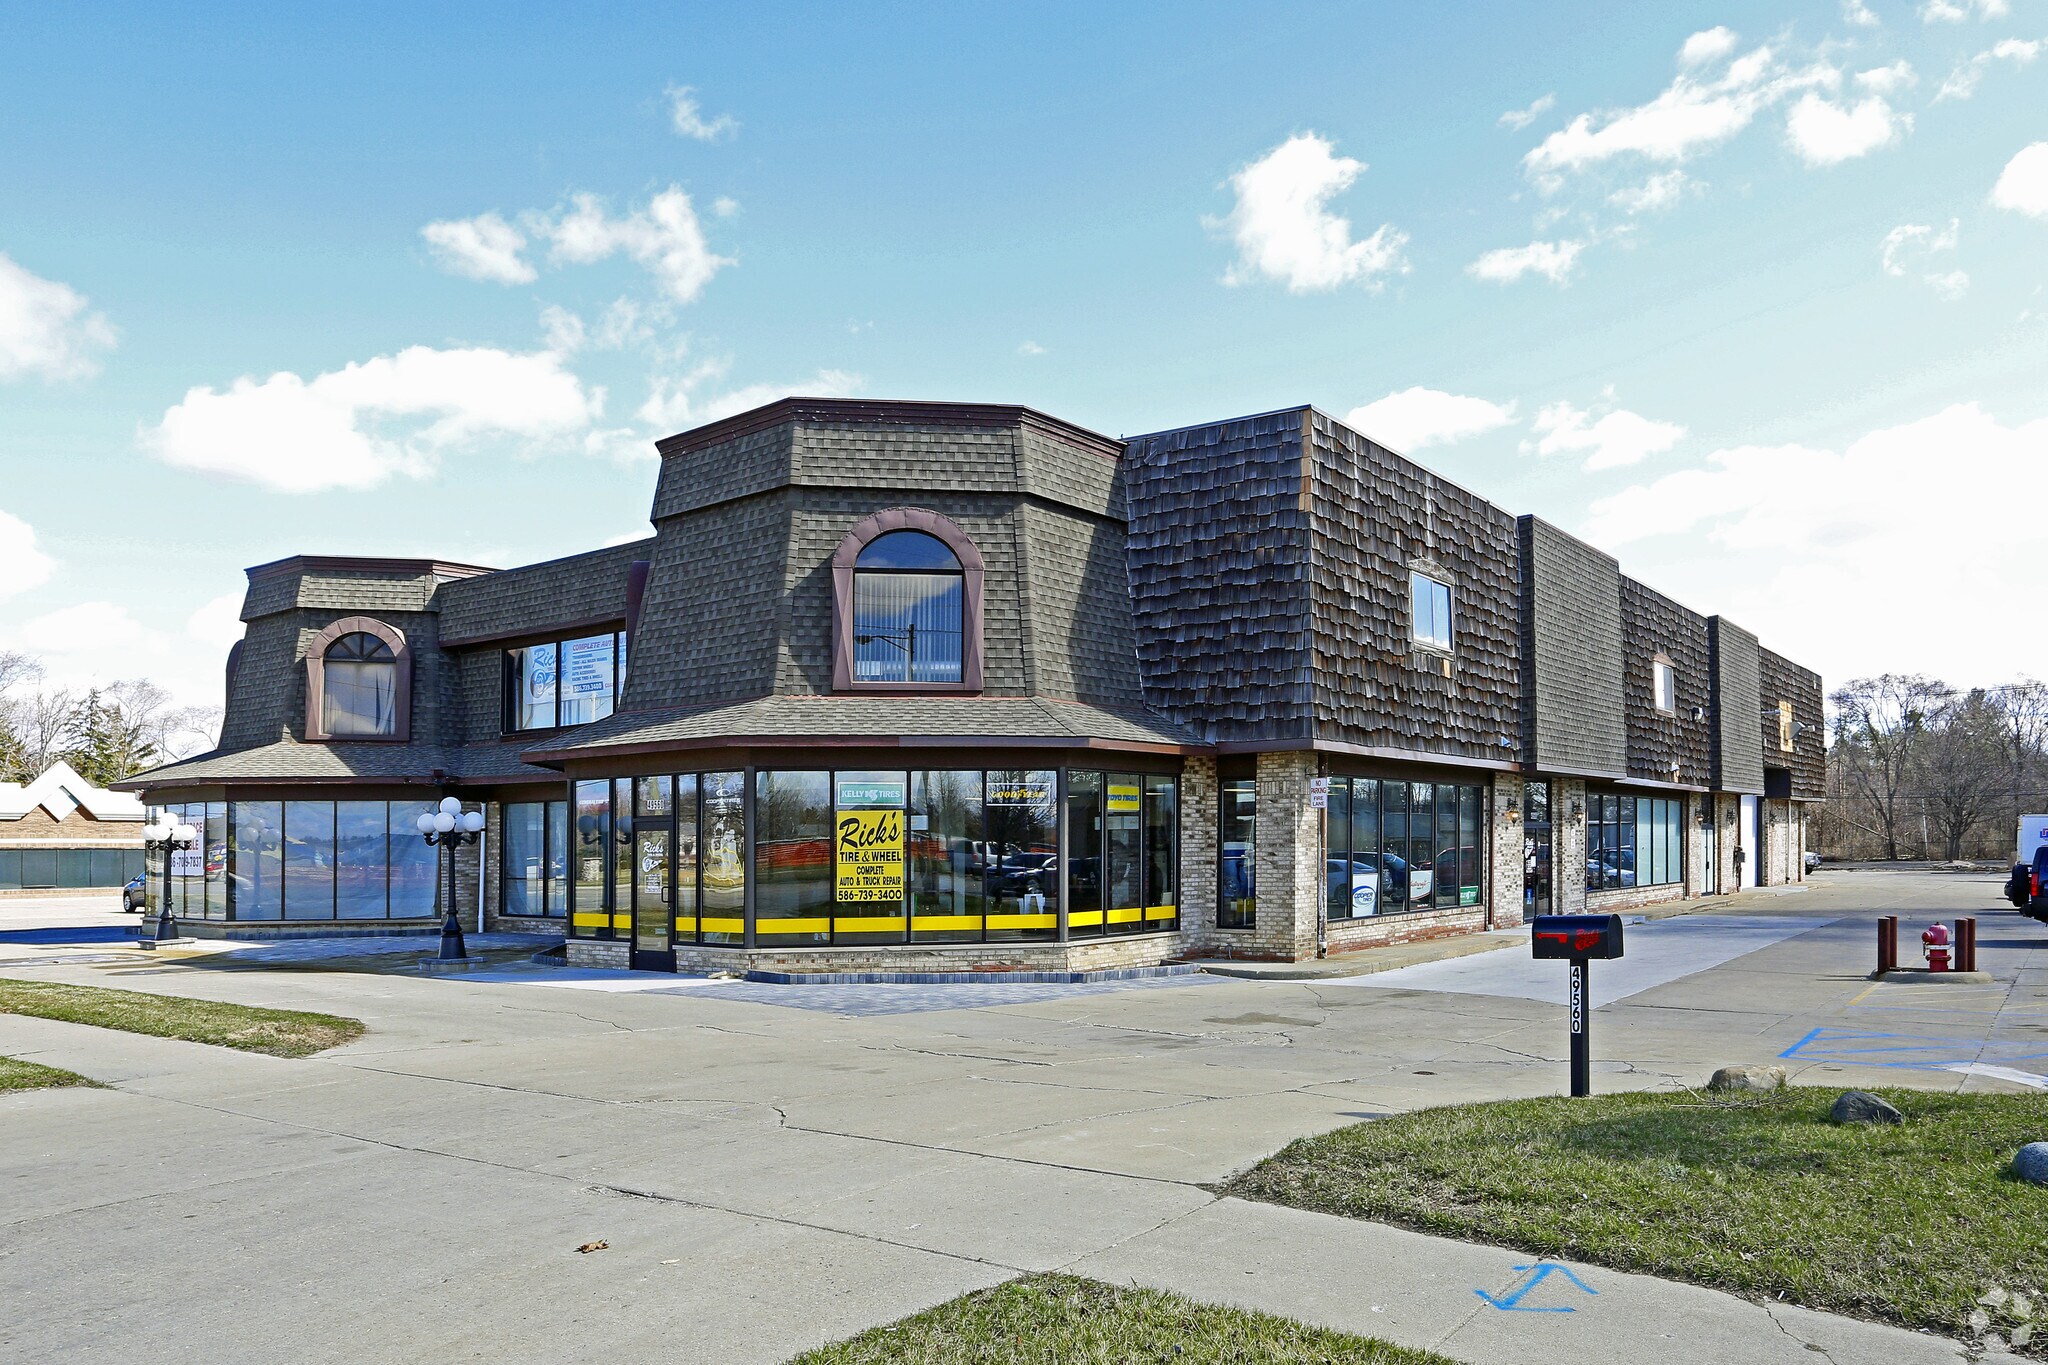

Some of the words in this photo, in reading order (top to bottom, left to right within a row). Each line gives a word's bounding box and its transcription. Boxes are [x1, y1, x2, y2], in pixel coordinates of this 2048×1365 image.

[573, 641, 601, 651] COMPLETE
[841, 790, 864, 798] KELLY
[879, 790, 901, 798] TIRES
[839, 812, 901, 851] Rick's
[840, 852, 859, 862] TIRE
[862, 851, 870, 862] &
[871, 852, 901, 862] WHEEL
[856, 866, 884, 875] COMPLETE
[839, 877, 854, 886] AUTO
[856, 877, 860, 886] &
[863, 877, 880, 886] TRUCK
[883, 876, 901, 885] REPAIR
[838, 890, 902, 900] 586-739-3400
[1572, 967, 1580, 1032] 49560
